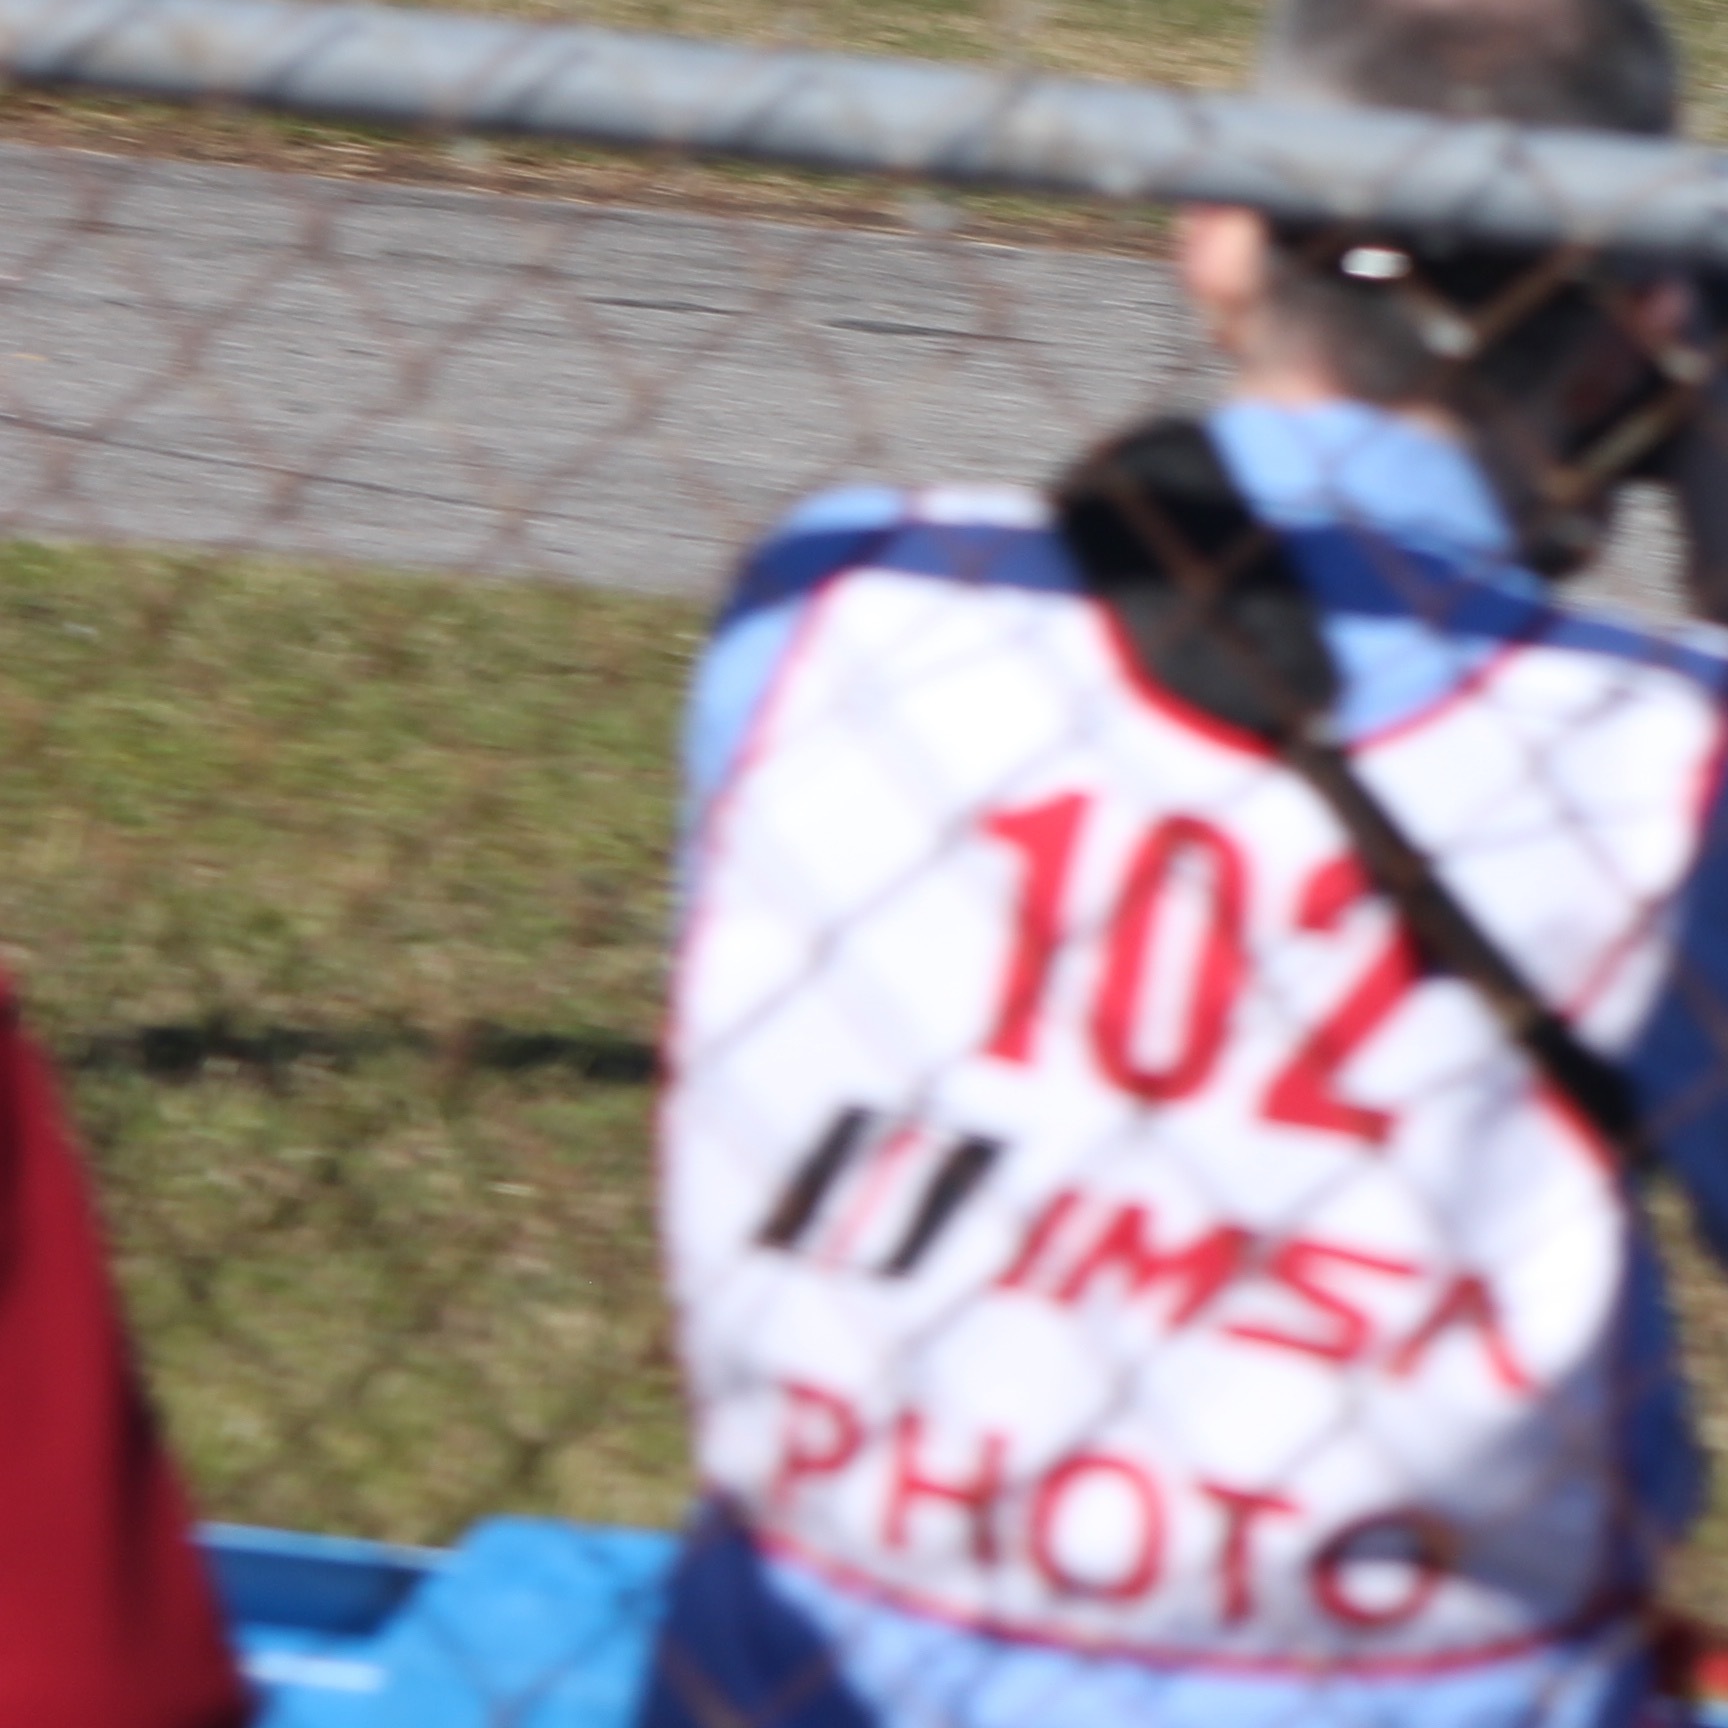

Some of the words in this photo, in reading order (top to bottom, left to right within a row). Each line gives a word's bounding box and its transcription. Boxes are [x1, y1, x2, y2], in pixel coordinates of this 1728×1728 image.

[972, 790, 1420, 1149] 102
[995, 1184, 1545, 1398] IMSA
[768, 1372, 1458, 1632] PHOTO
